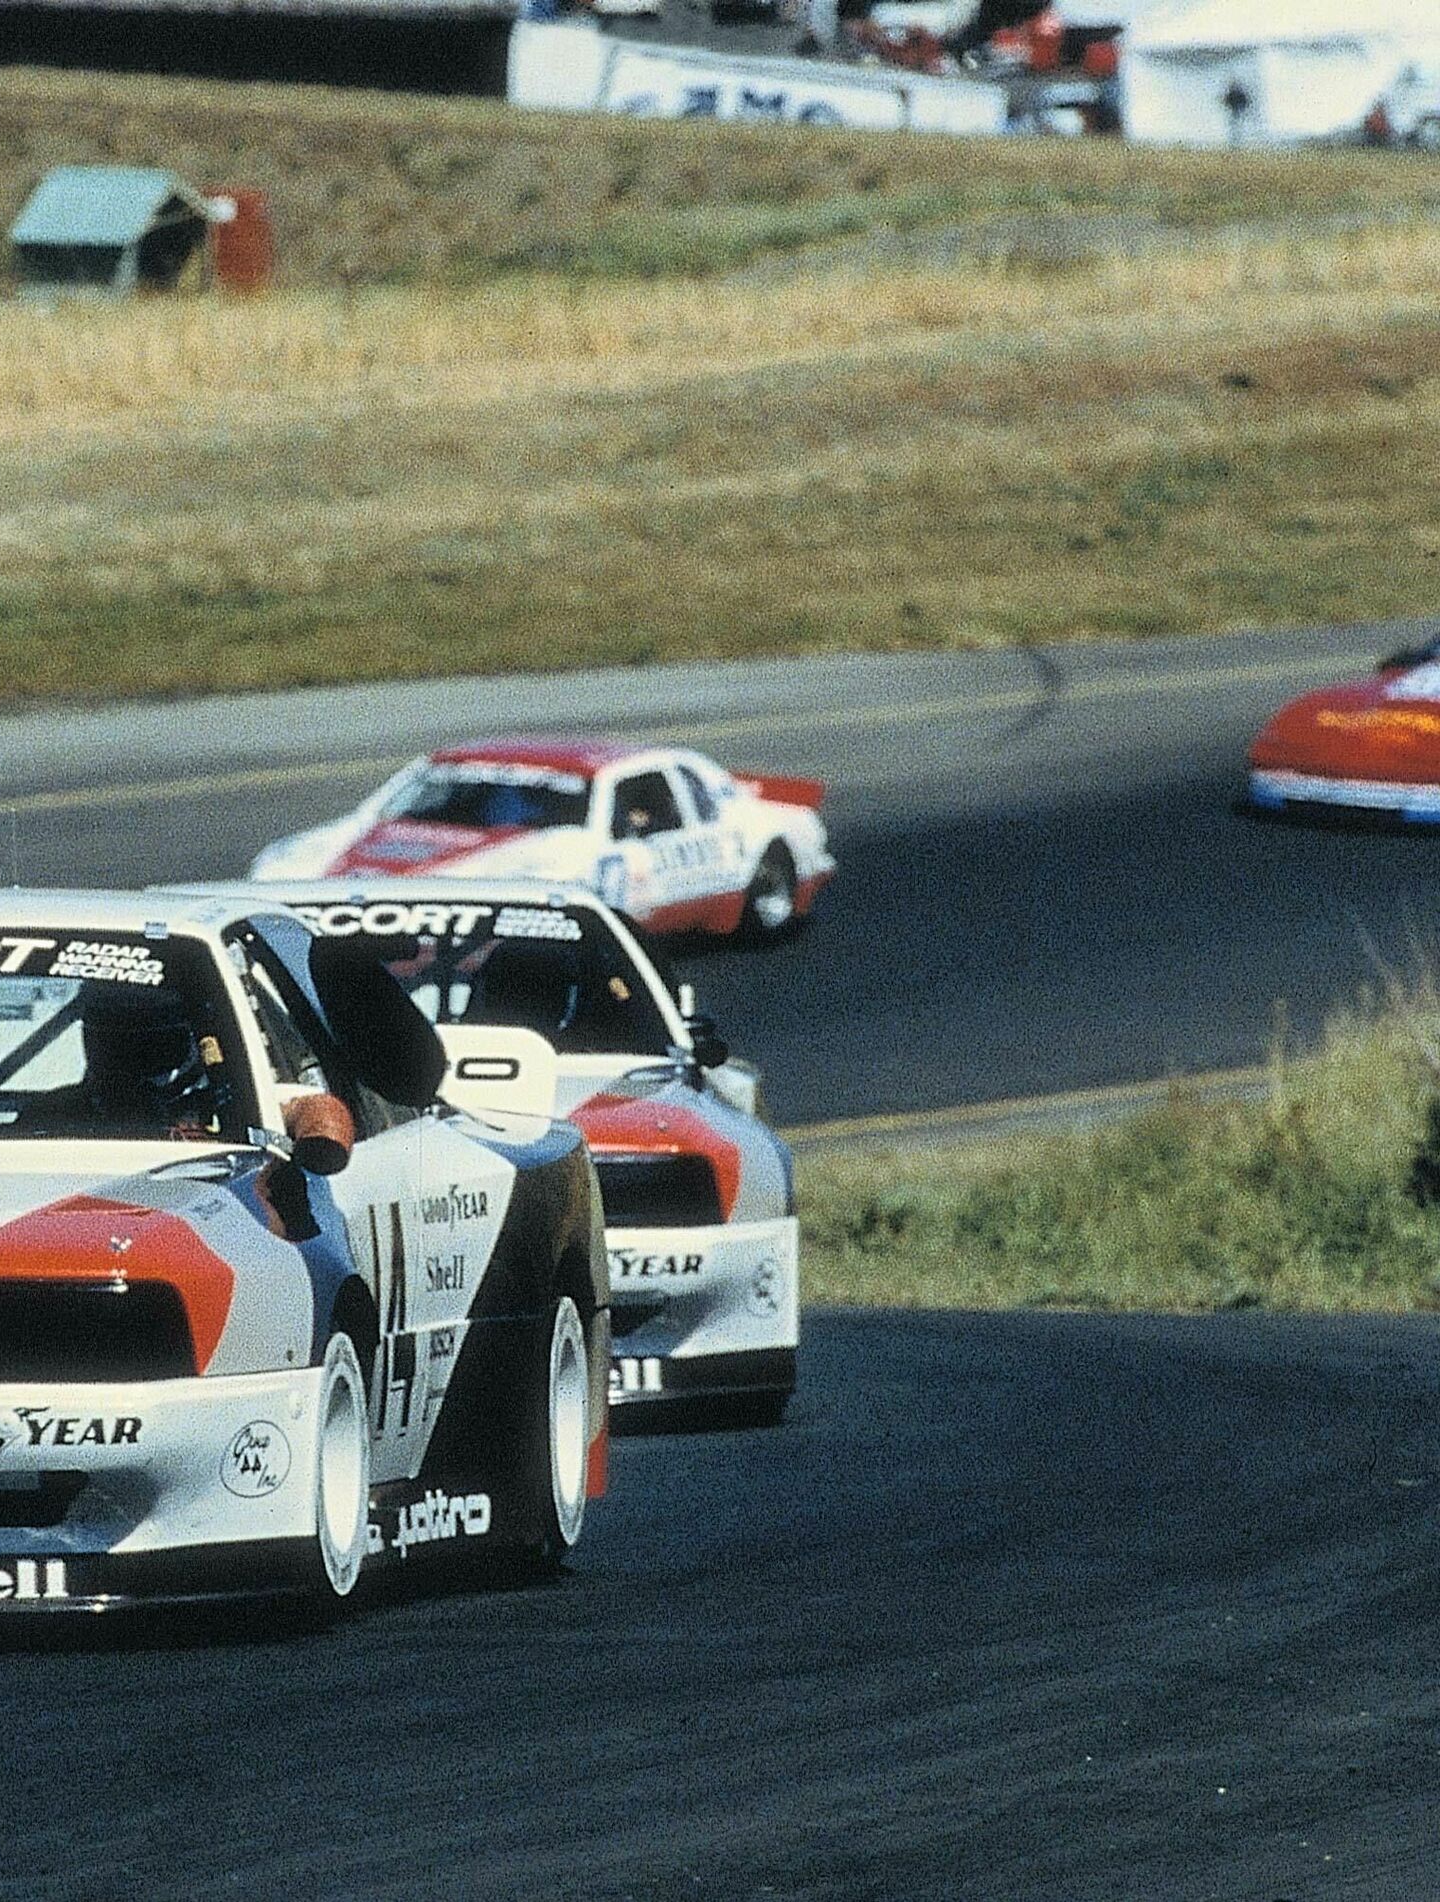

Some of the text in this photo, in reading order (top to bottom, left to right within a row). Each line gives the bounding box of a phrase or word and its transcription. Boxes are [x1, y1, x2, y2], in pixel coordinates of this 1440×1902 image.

[66, 941, 150, 960] RADAR
[58, 951, 164, 973] WARNING
[49, 963, 165, 986] RECEIVER
[426, 1254, 465, 1293] Shell
